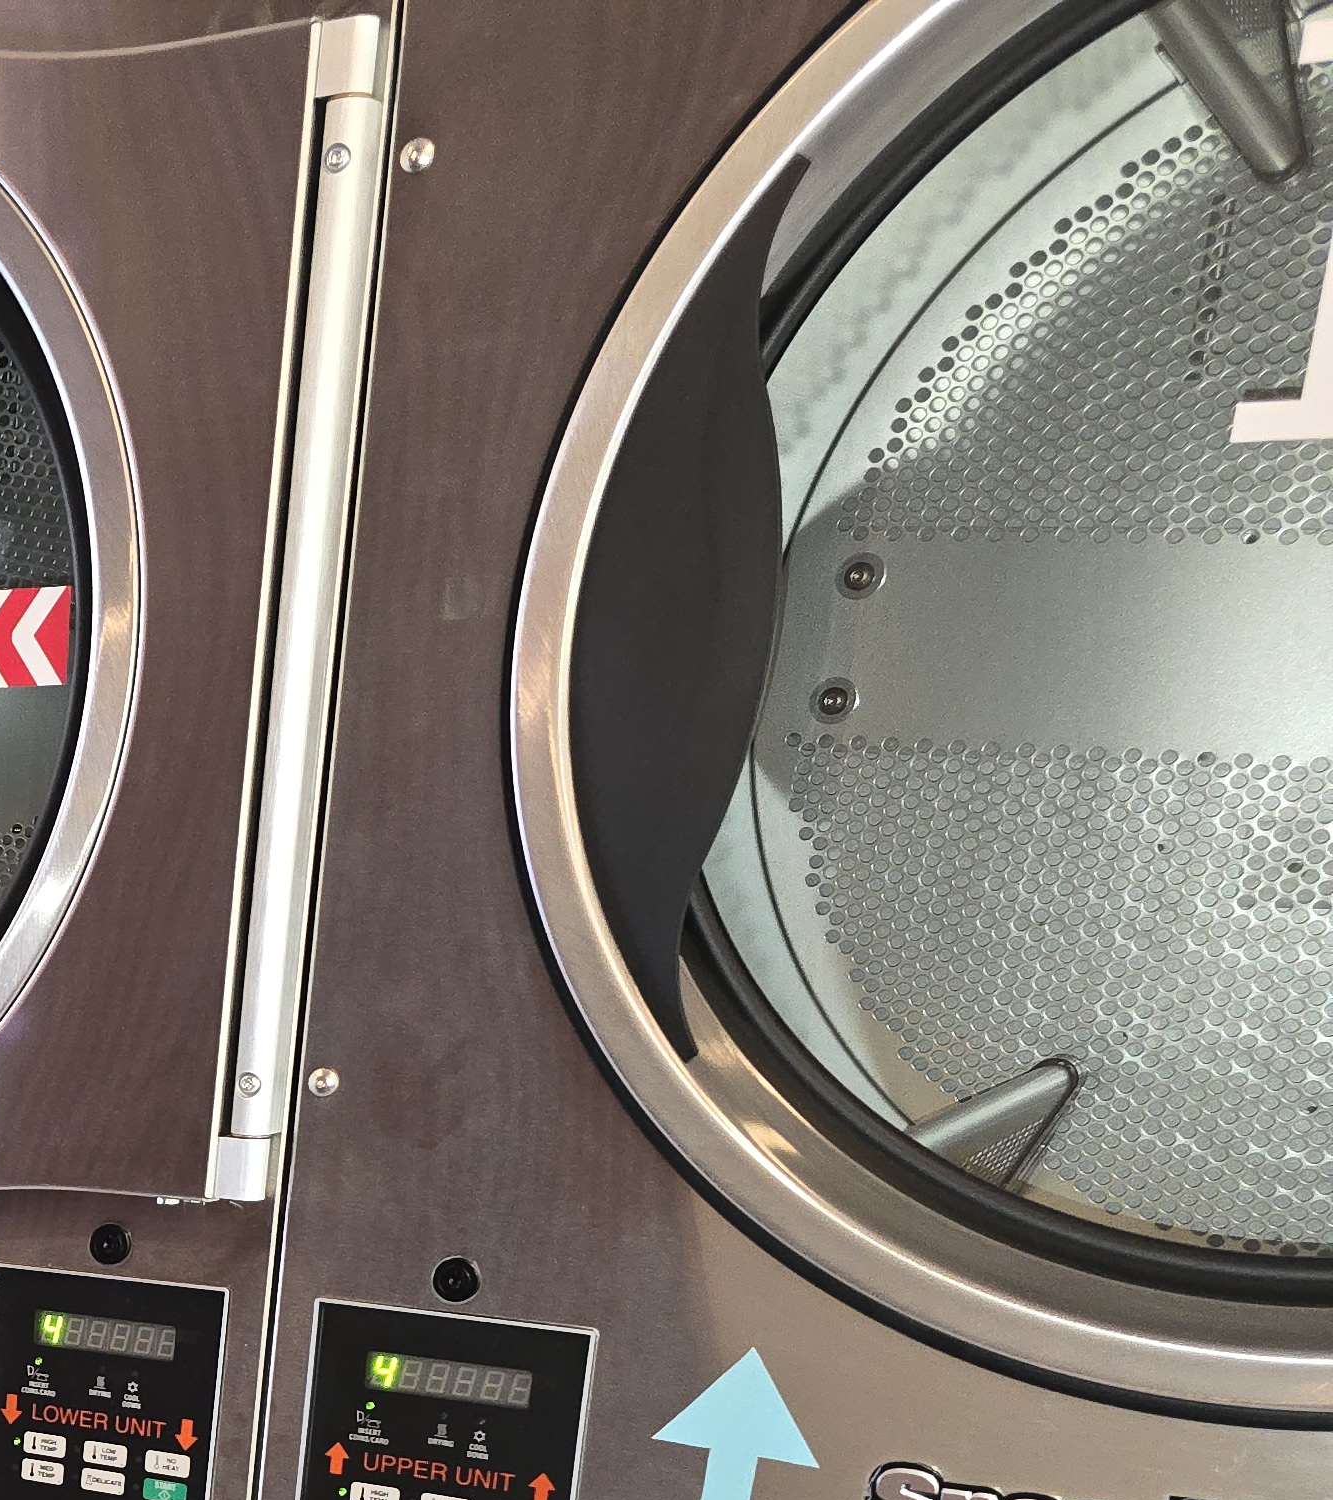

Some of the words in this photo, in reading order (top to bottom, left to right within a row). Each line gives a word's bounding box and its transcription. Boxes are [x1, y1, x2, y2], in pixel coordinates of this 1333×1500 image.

[42, 1313, 64, 1344] 4
[374, 1354, 399, 1389] 4
[31, 1403, 110, 1431] LOWER
[115, 1416, 167, 1439] UNIT
[40, 1438, 57, 1446] HIGH
[101, 1447, 117, 1455] LOW
[165, 1457, 178, 1465] NO
[363, 1451, 448, 1483] UPPER
[455, 1465, 516, 1492] UNIT
[369, 1489, 390, 1498] HIGH
